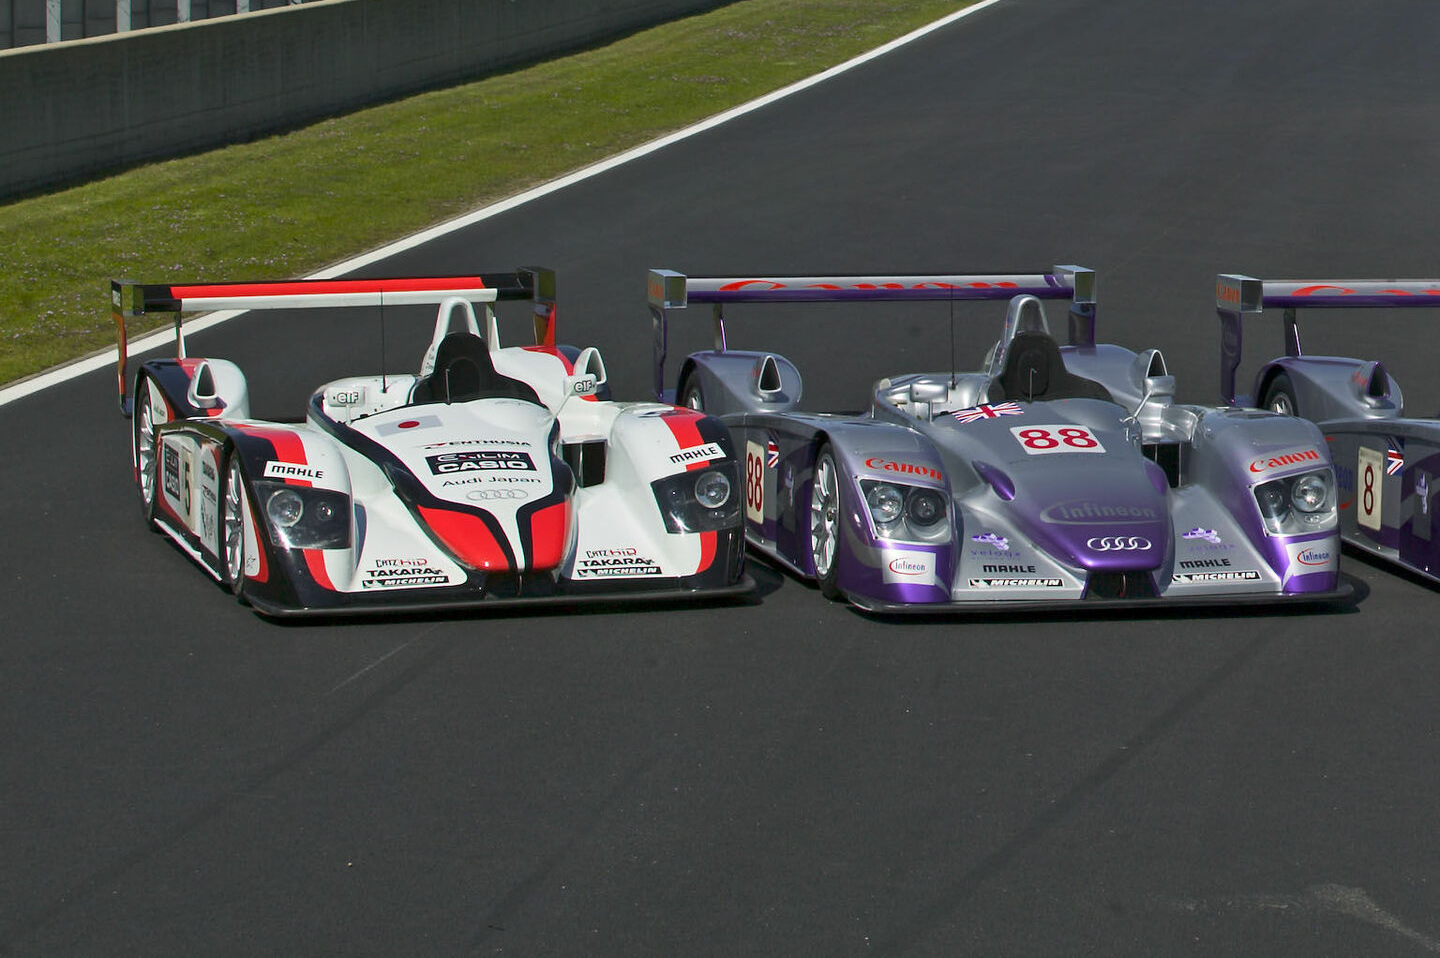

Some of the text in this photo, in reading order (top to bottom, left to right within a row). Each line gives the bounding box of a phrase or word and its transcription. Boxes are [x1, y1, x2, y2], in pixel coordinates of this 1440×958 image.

[574, 380, 593, 392] elf
[337, 392, 359, 404] elf
[1019, 428, 1098, 449] 88
[669, 447, 718, 465] MAHLE
[1250, 449, 1320, 473] Canon
[271, 465, 324, 479] MAHLE
[438, 460, 528, 472] CASIO
[865, 457, 942, 481] Canon
[443, 476, 541, 487] Audi Japan
[747, 452, 762, 512] 88
[184, 461, 191, 516] 5
[1363, 464, 1374, 516] 8
[579, 558, 650, 567] TAKARA
[983, 564, 1036, 573] MAHLE
[1179, 558, 1231, 569] MAHLE
[366, 568, 435, 577] TAKARA
[597, 567, 657, 575] MICHELIN
[1191, 572, 1256, 581] MICHELIN
[384, 576, 445, 585] MICHELIN
